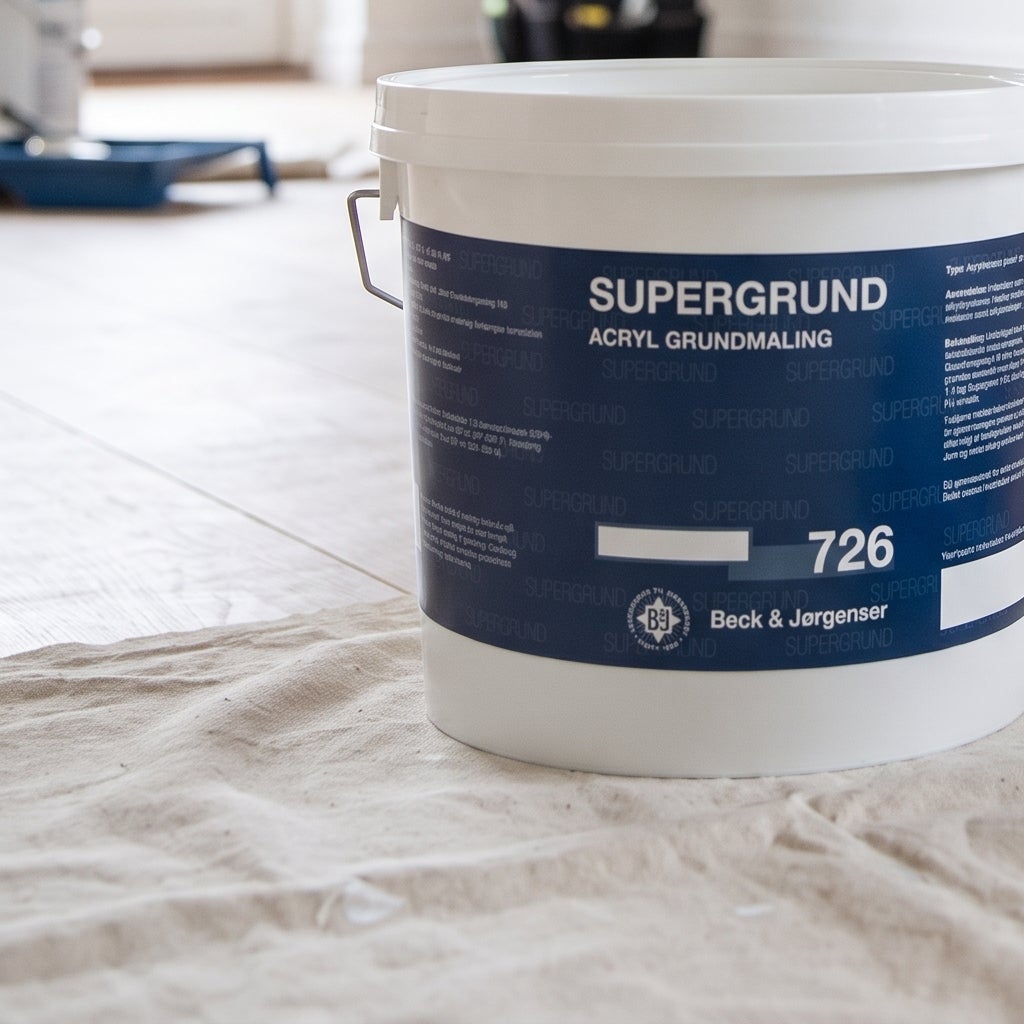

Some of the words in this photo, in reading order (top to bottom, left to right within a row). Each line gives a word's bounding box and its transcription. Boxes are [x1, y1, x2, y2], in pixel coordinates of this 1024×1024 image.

[589, 276, 888, 316] SUPERGRUND
[588, 327, 659, 348] ACRYL
[665, 329, 832, 351] GRUNDMALING
[808, 525, 894, 574] 726
[710, 609, 763, 629] Beck
[768, 608, 784, 628] &
[789, 604, 888, 630] Jørgenser
